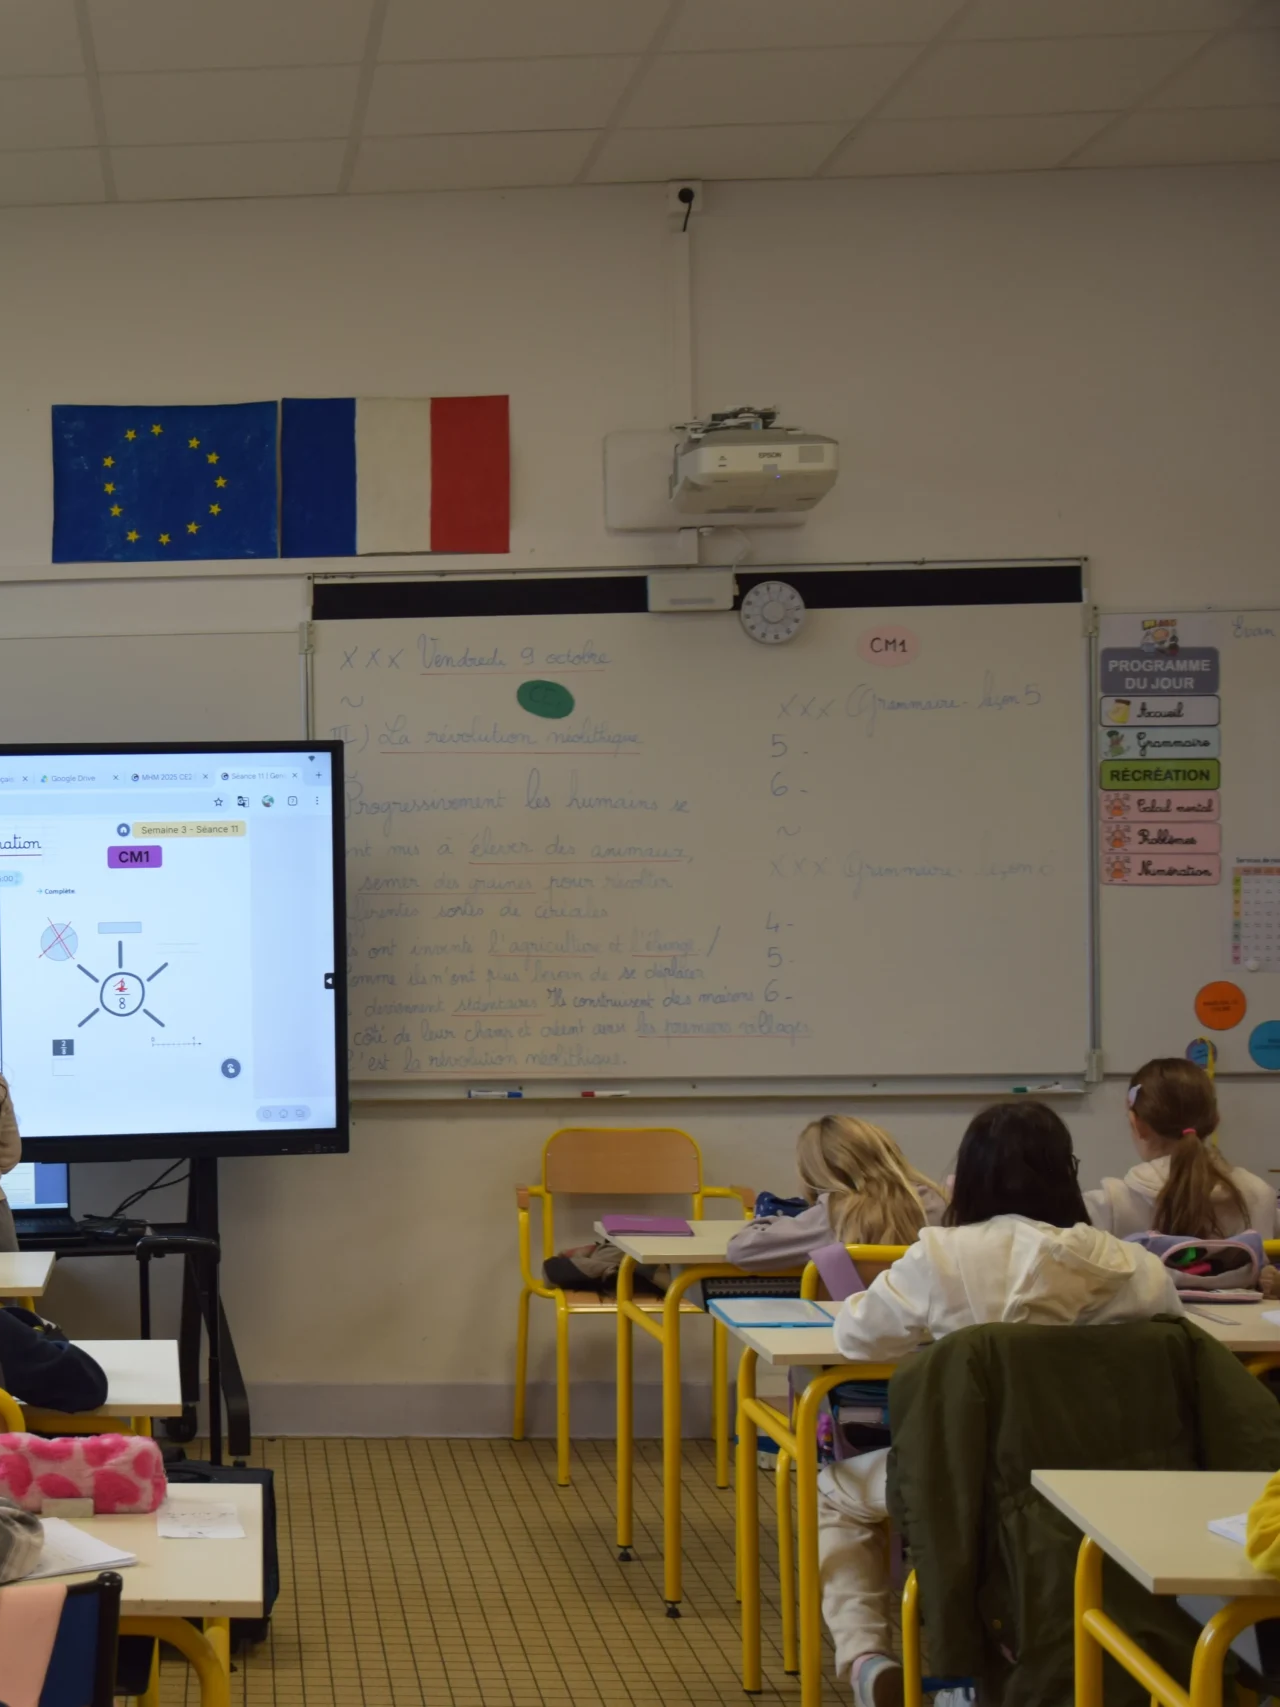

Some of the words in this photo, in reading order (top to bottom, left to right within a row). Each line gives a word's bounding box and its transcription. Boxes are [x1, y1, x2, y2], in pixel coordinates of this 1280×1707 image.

[417, 632, 506, 669] Vendredi
[520, 647, 536, 665] 9
[545, 639, 611, 665] octobre
[869, 637, 909, 653] CM1
[1107, 659, 1212, 672] PROGRAMME
[1124, 677, 1148, 690] DU
[1150, 677, 1195, 690] JOUR
[845, 683, 960, 738] Grammaire
[1024, 683, 1042, 706] 5
[1136, 701, 1185, 718] Accueil
[377, 713, 412, 746] La
[424, 715, 537, 746] révolution
[1136, 731, 1211, 757] Grammaire
[51, 774, 77, 783] Google
[77, 774, 96, 782] Drive
[160, 773, 178, 781] 2025
[1109, 767, 1211, 782] RÉCRÉATION
[524, 767, 551, 810] les
[565, 768, 659, 811] humains
[1136, 798, 1172, 813] Calcul
[1176, 798, 1214, 813] mental
[141, 825, 177, 835] Semaine
[180, 825, 187, 835] 3
[196, 823, 229, 834] Séance
[230, 824, 239, 834] 11
[1137, 828, 1198, 846] Problèmes
[544, 834, 576, 855] des
[118, 850, 151, 863] CM1
[1137, 859, 1213, 877] Numération
[118, 996, 126, 1010] 8
